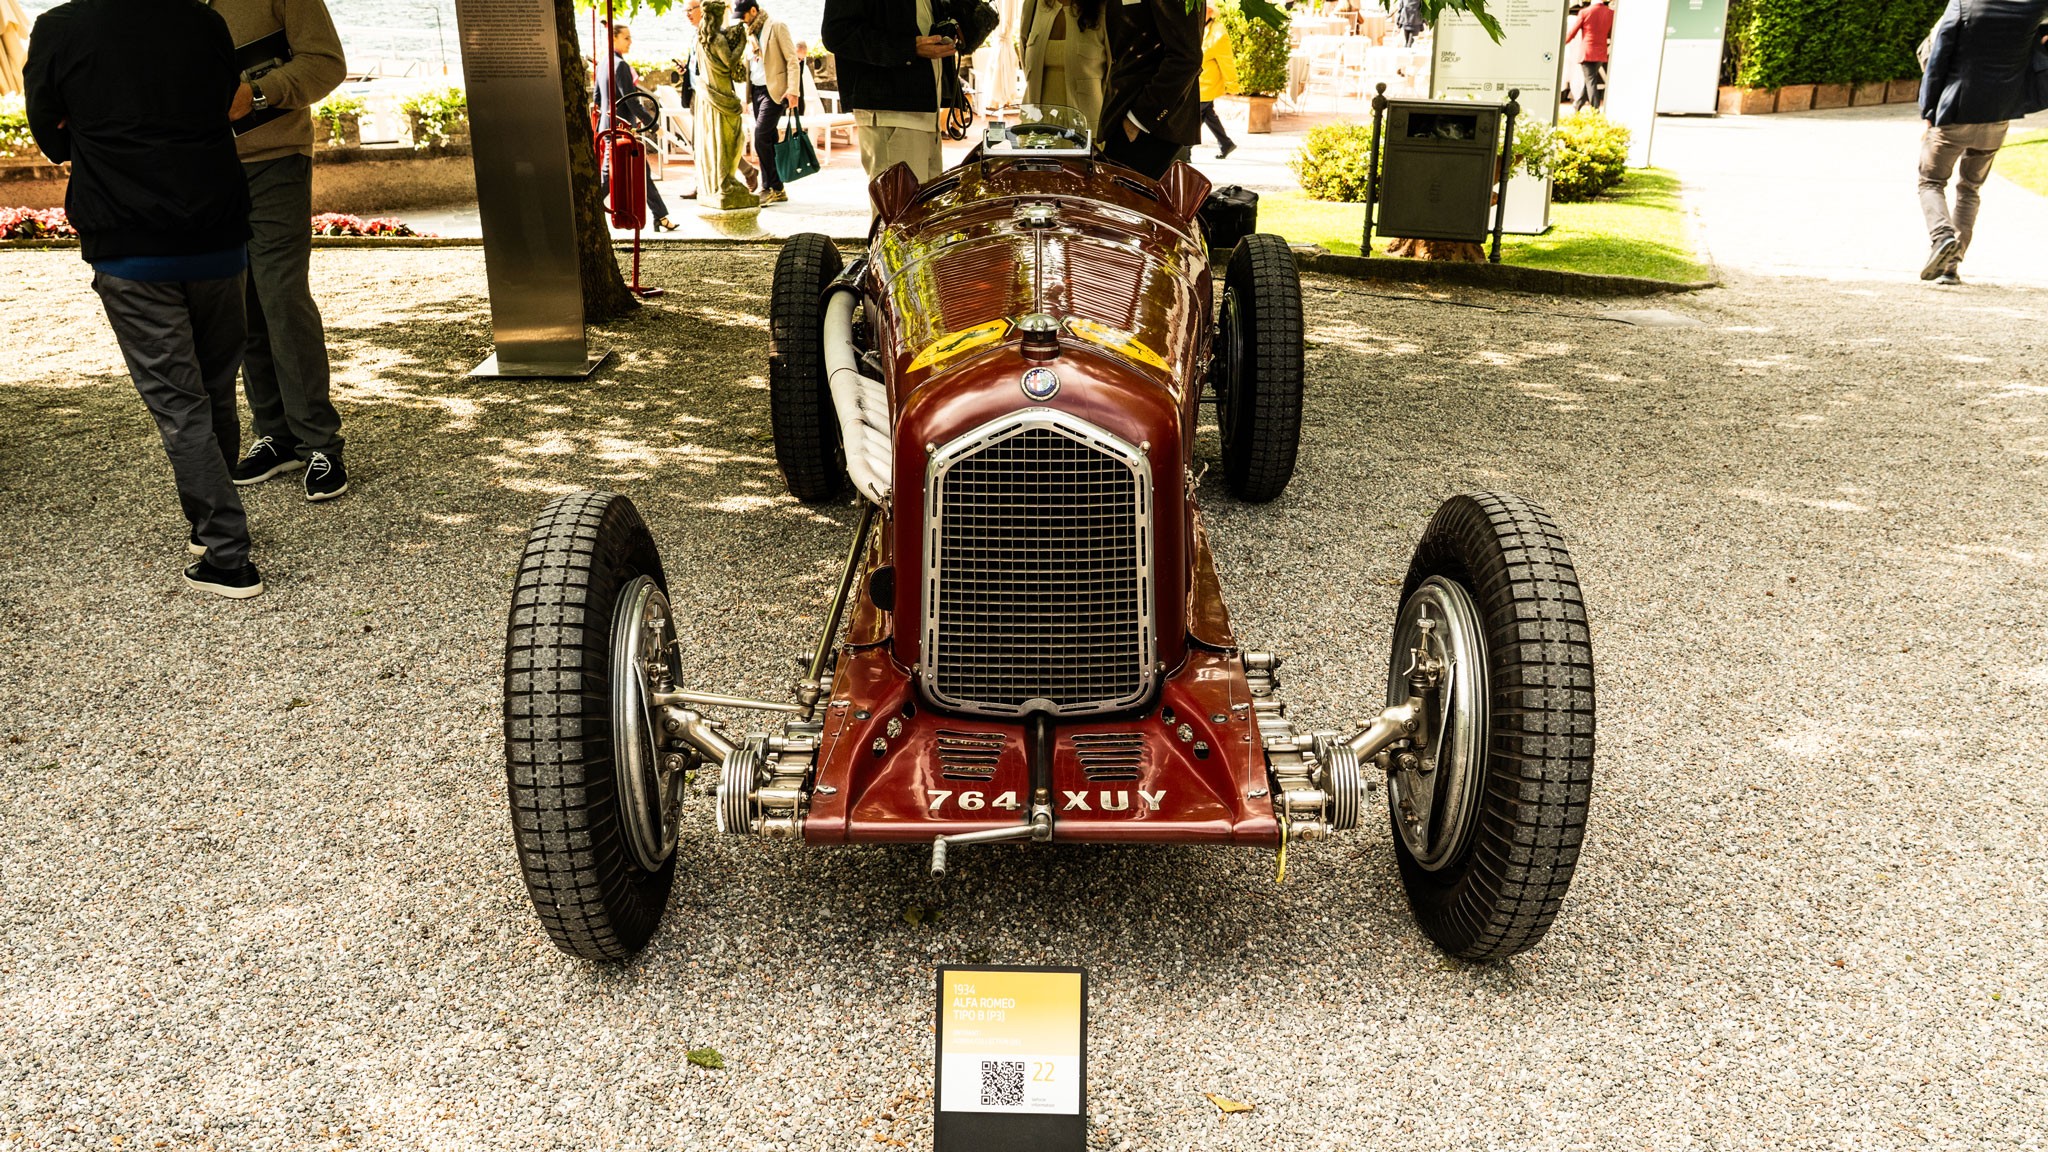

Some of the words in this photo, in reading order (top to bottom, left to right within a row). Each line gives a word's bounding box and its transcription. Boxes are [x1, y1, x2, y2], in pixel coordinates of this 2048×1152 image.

[927, 790, 1020, 811] 764
[1062, 790, 1167, 811] XUY
[953, 984, 976, 995] 1934
[953, 997, 978, 1008] ALFA
[980, 997, 1016, 1009] ROMEO
[953, 1010, 976, 1021] TIPO
[977, 1010, 985, 1021] B
[1032, 1061, 1055, 1082] 22
